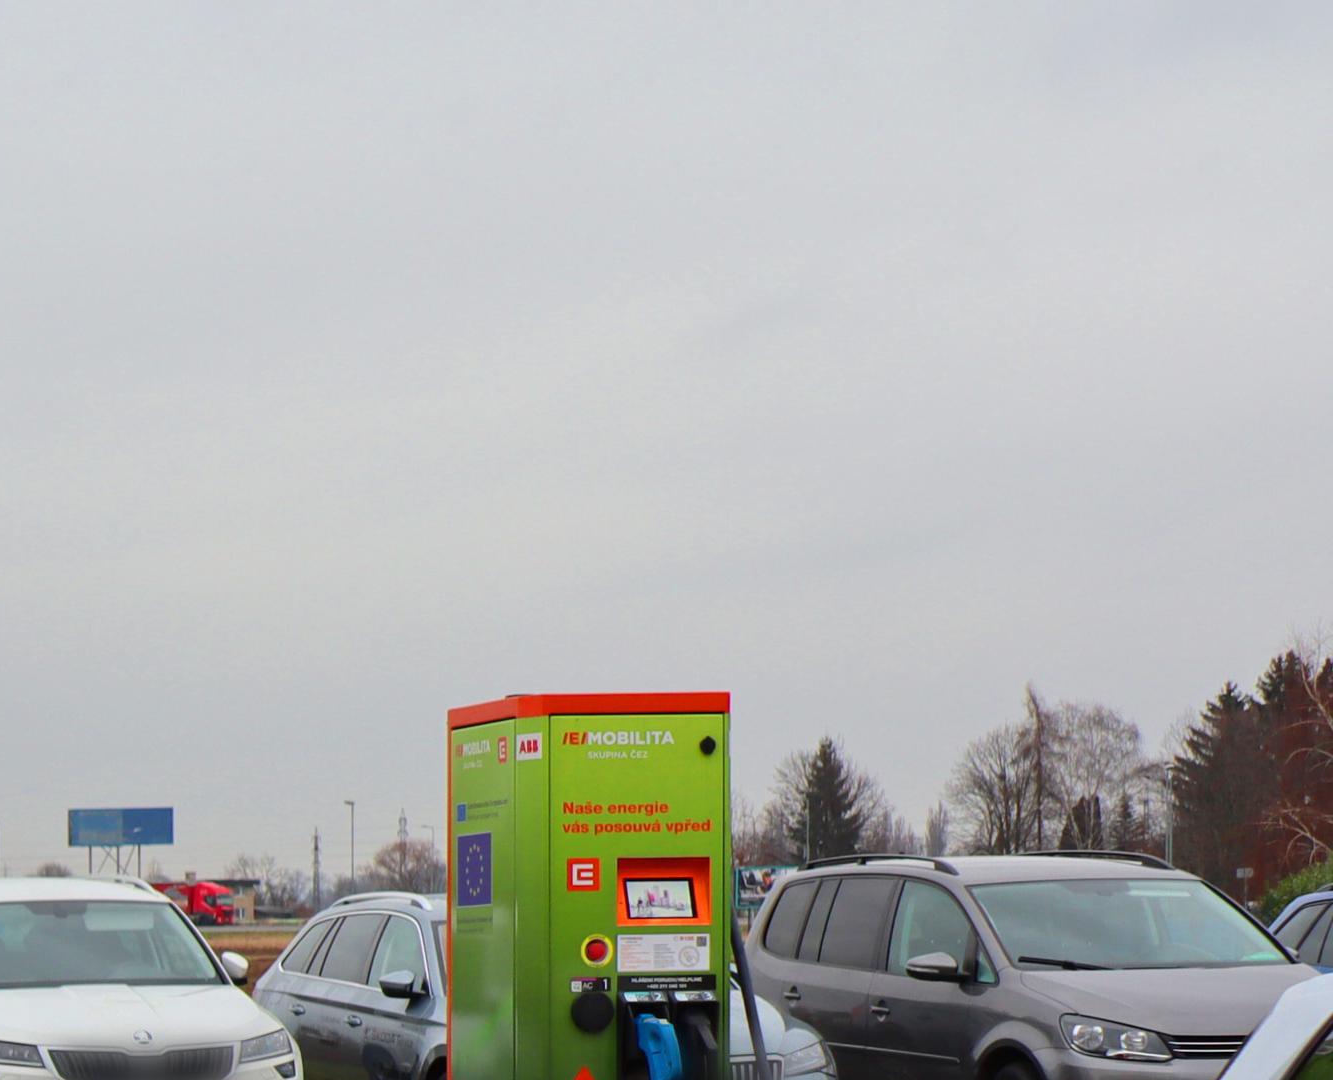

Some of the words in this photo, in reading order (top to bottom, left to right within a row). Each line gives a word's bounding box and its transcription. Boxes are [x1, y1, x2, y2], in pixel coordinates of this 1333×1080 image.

[519, 739, 539, 754] ABB
[587, 751, 628, 760] SKUPINA
[630, 748, 649, 759] ČEZ
[563, 800, 603, 815] Naše
[608, 801, 669, 816] energie
[562, 820, 589, 834] vás
[594, 819, 661, 836] posouvá
[665, 818, 712, 835] vpřed
[582, 982, 593, 990] AC
[603, 979, 608, 989] 1
